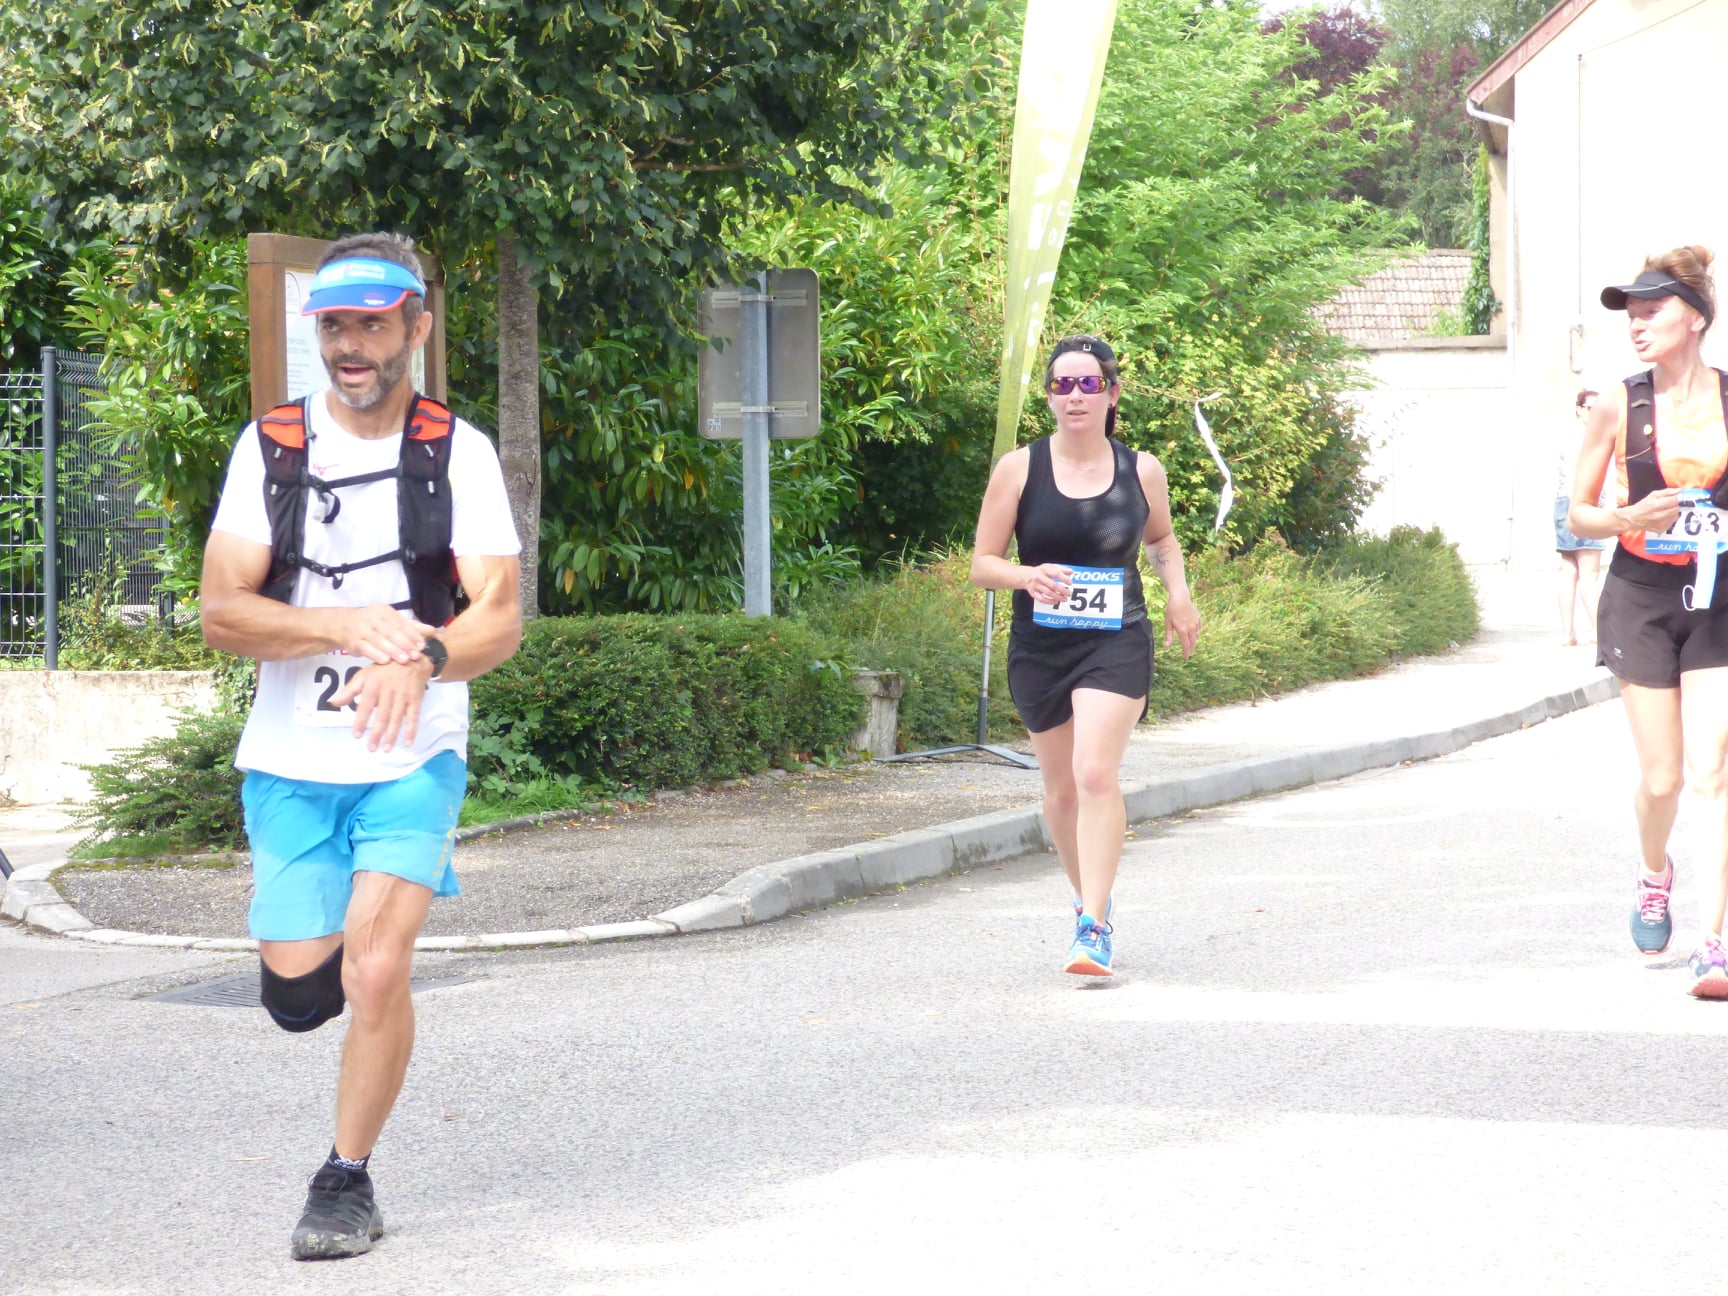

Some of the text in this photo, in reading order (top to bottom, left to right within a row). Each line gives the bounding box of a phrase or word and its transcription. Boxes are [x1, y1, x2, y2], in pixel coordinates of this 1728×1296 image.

[1069, 571, 1121, 582] ROOKS
[1052, 587, 1107, 613] 54
[1043, 616, 1109, 629] run happy
